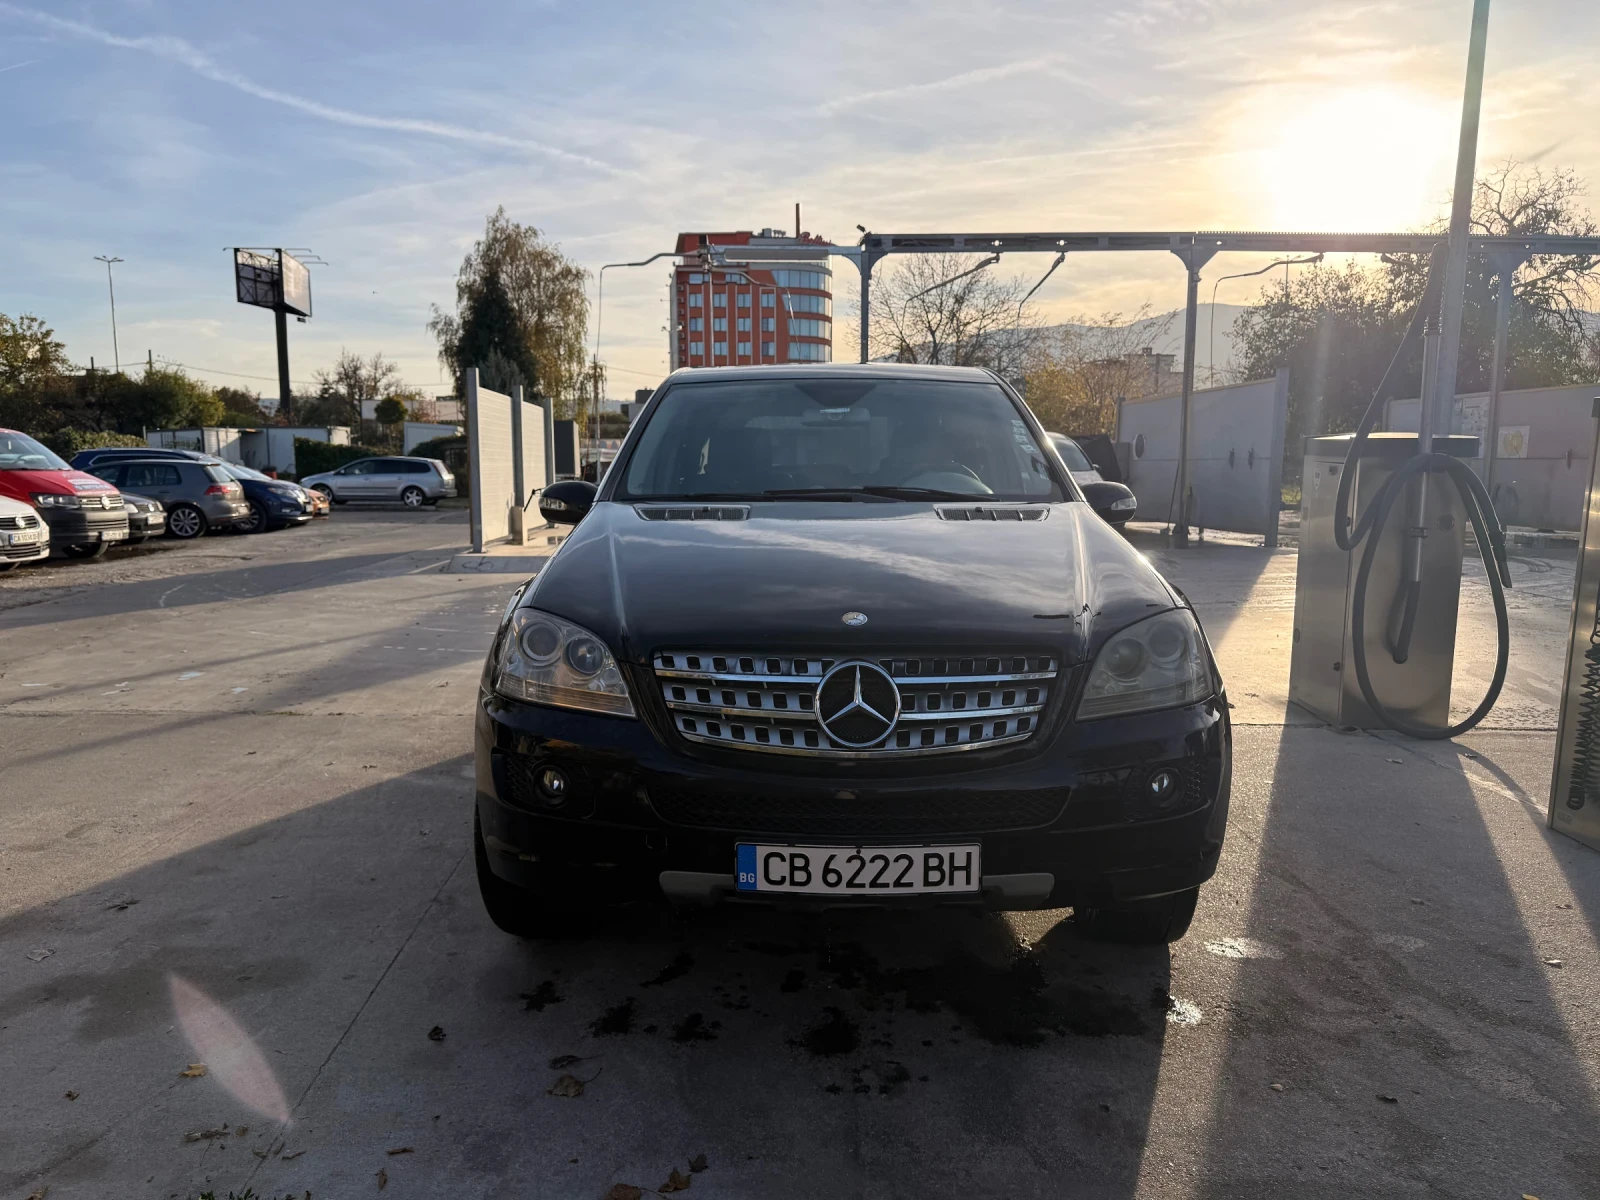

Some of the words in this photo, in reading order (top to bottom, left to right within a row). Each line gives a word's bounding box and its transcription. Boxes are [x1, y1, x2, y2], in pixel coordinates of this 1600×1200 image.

[739, 872, 755, 883] BG
[763, 851, 812, 887] CB
[821, 853, 914, 889] 6222
[922, 851, 972, 887] BH
